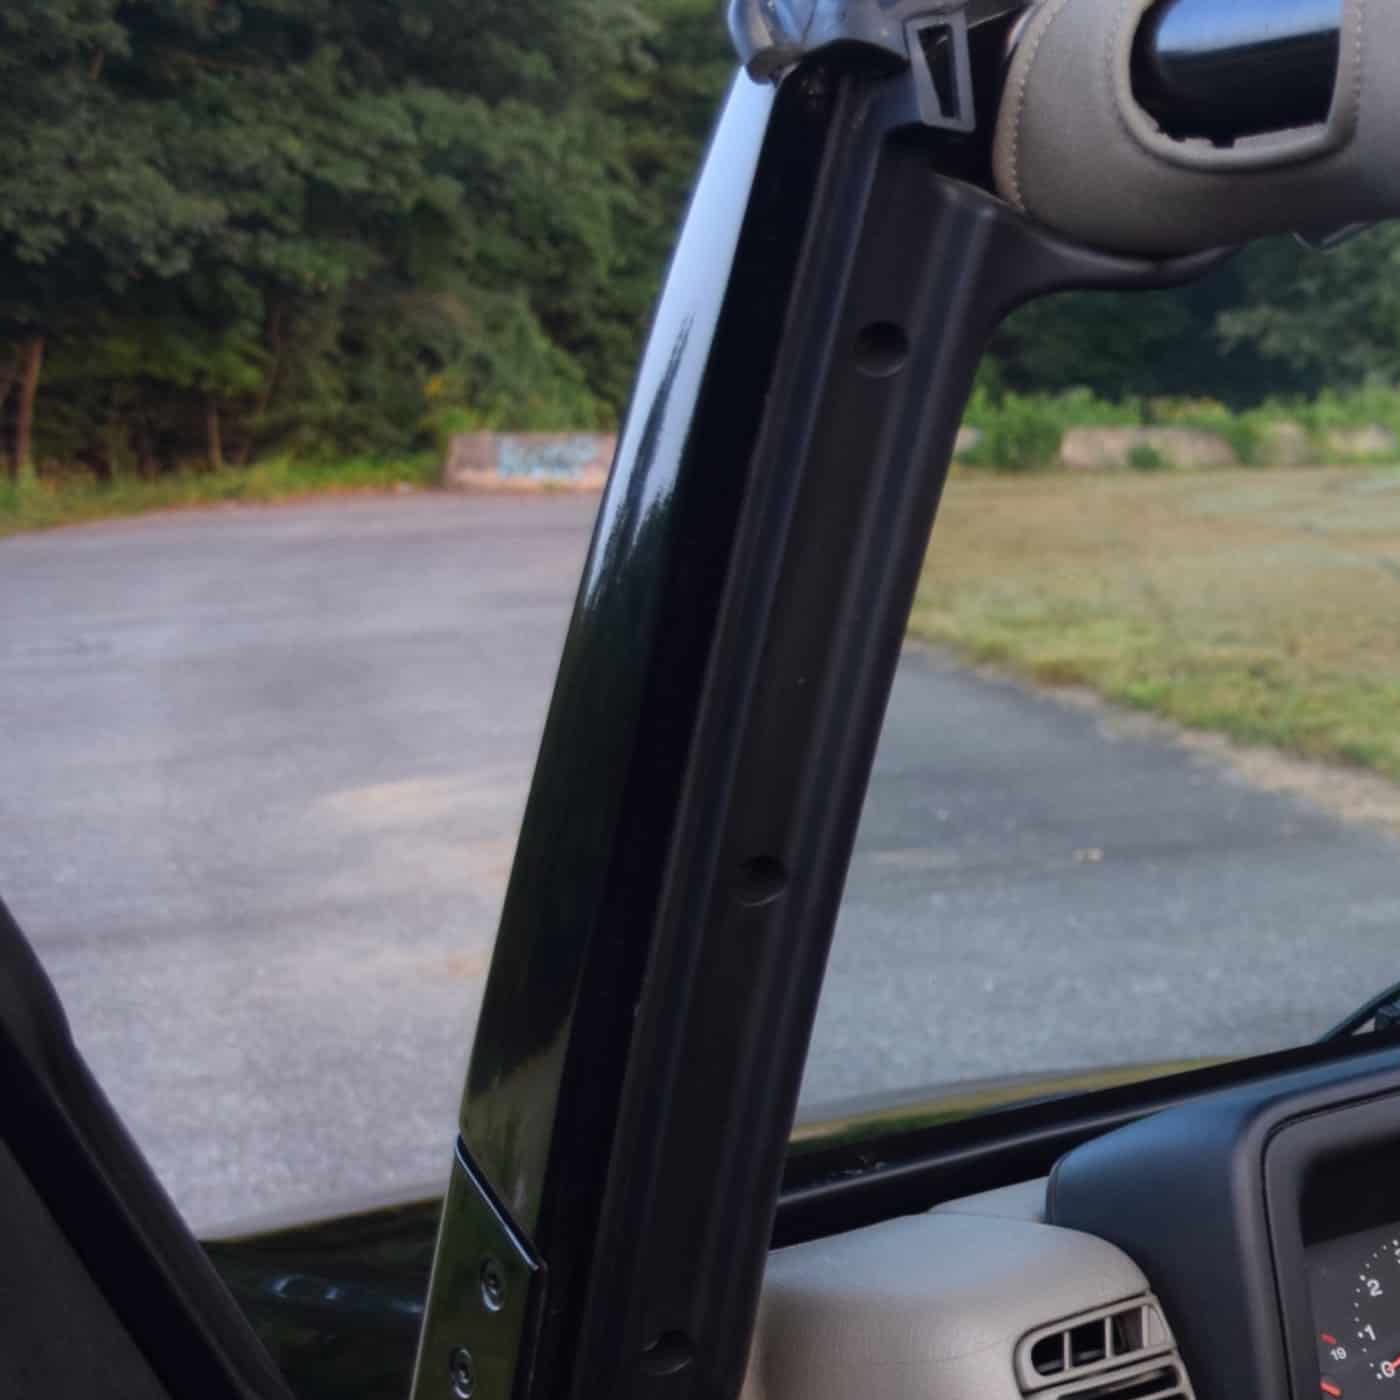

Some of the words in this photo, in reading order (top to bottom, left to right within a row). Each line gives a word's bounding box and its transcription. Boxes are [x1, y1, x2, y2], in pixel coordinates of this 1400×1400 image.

[1366, 1279, 1383, 1297] 2
[1364, 1324, 1376, 1341] 1
[1381, 1360, 1396, 1378] 0
